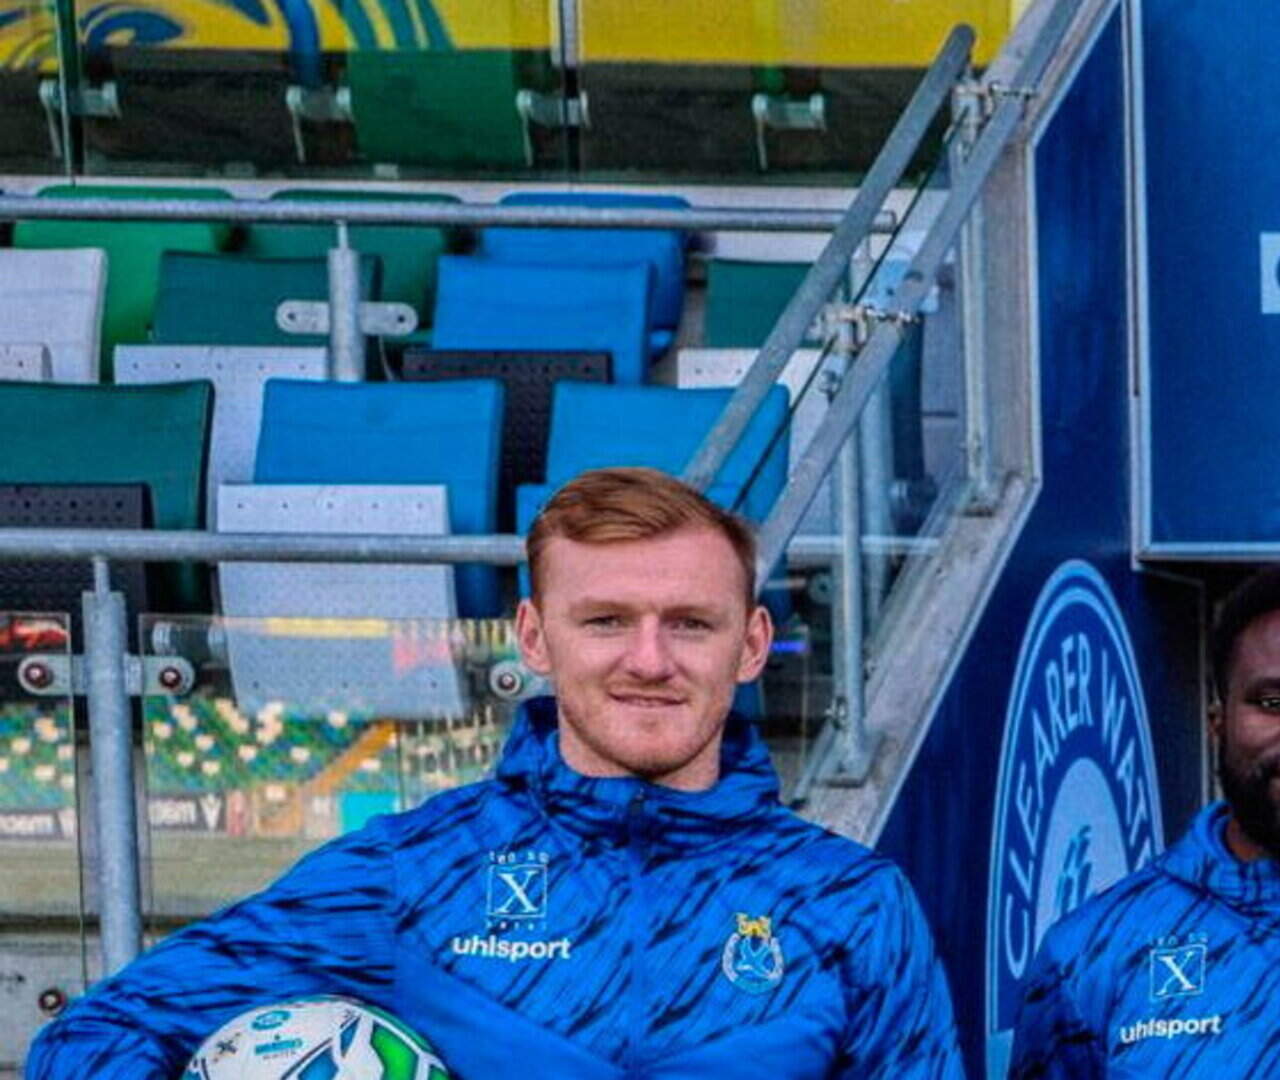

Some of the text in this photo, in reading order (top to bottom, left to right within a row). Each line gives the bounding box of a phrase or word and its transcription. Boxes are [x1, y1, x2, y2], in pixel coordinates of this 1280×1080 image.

[1005, 632, 1094, 980] CLEARER
[452, 933, 572, 963] uhlsport
[1120, 1014, 1222, 1044] uhlsport
